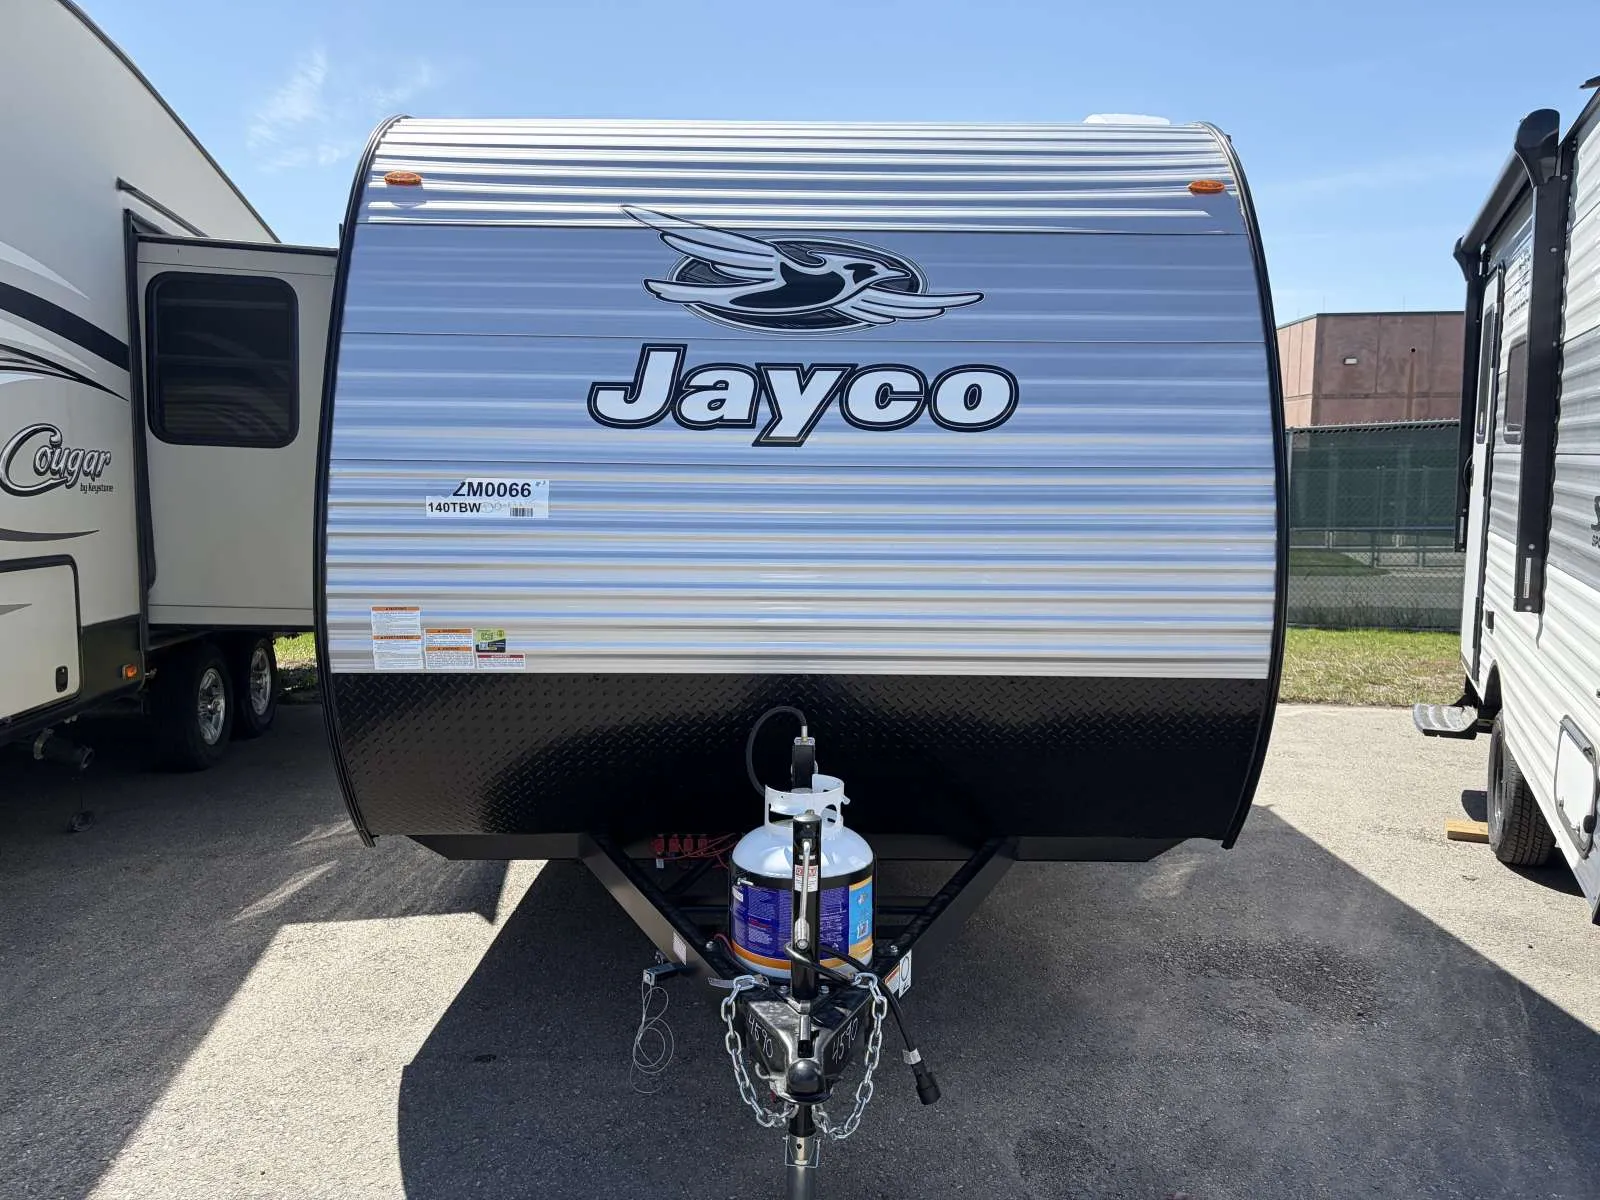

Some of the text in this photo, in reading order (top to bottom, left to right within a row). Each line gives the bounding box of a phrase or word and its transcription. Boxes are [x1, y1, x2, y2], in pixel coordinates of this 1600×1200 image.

[587, 343, 1020, 447] Jayco
[0, 423, 111, 497] Cougar
[88, 482, 114, 494] Keystone
[452, 481, 532, 497] ZM0066
[428, 502, 482, 513] 140TBW
